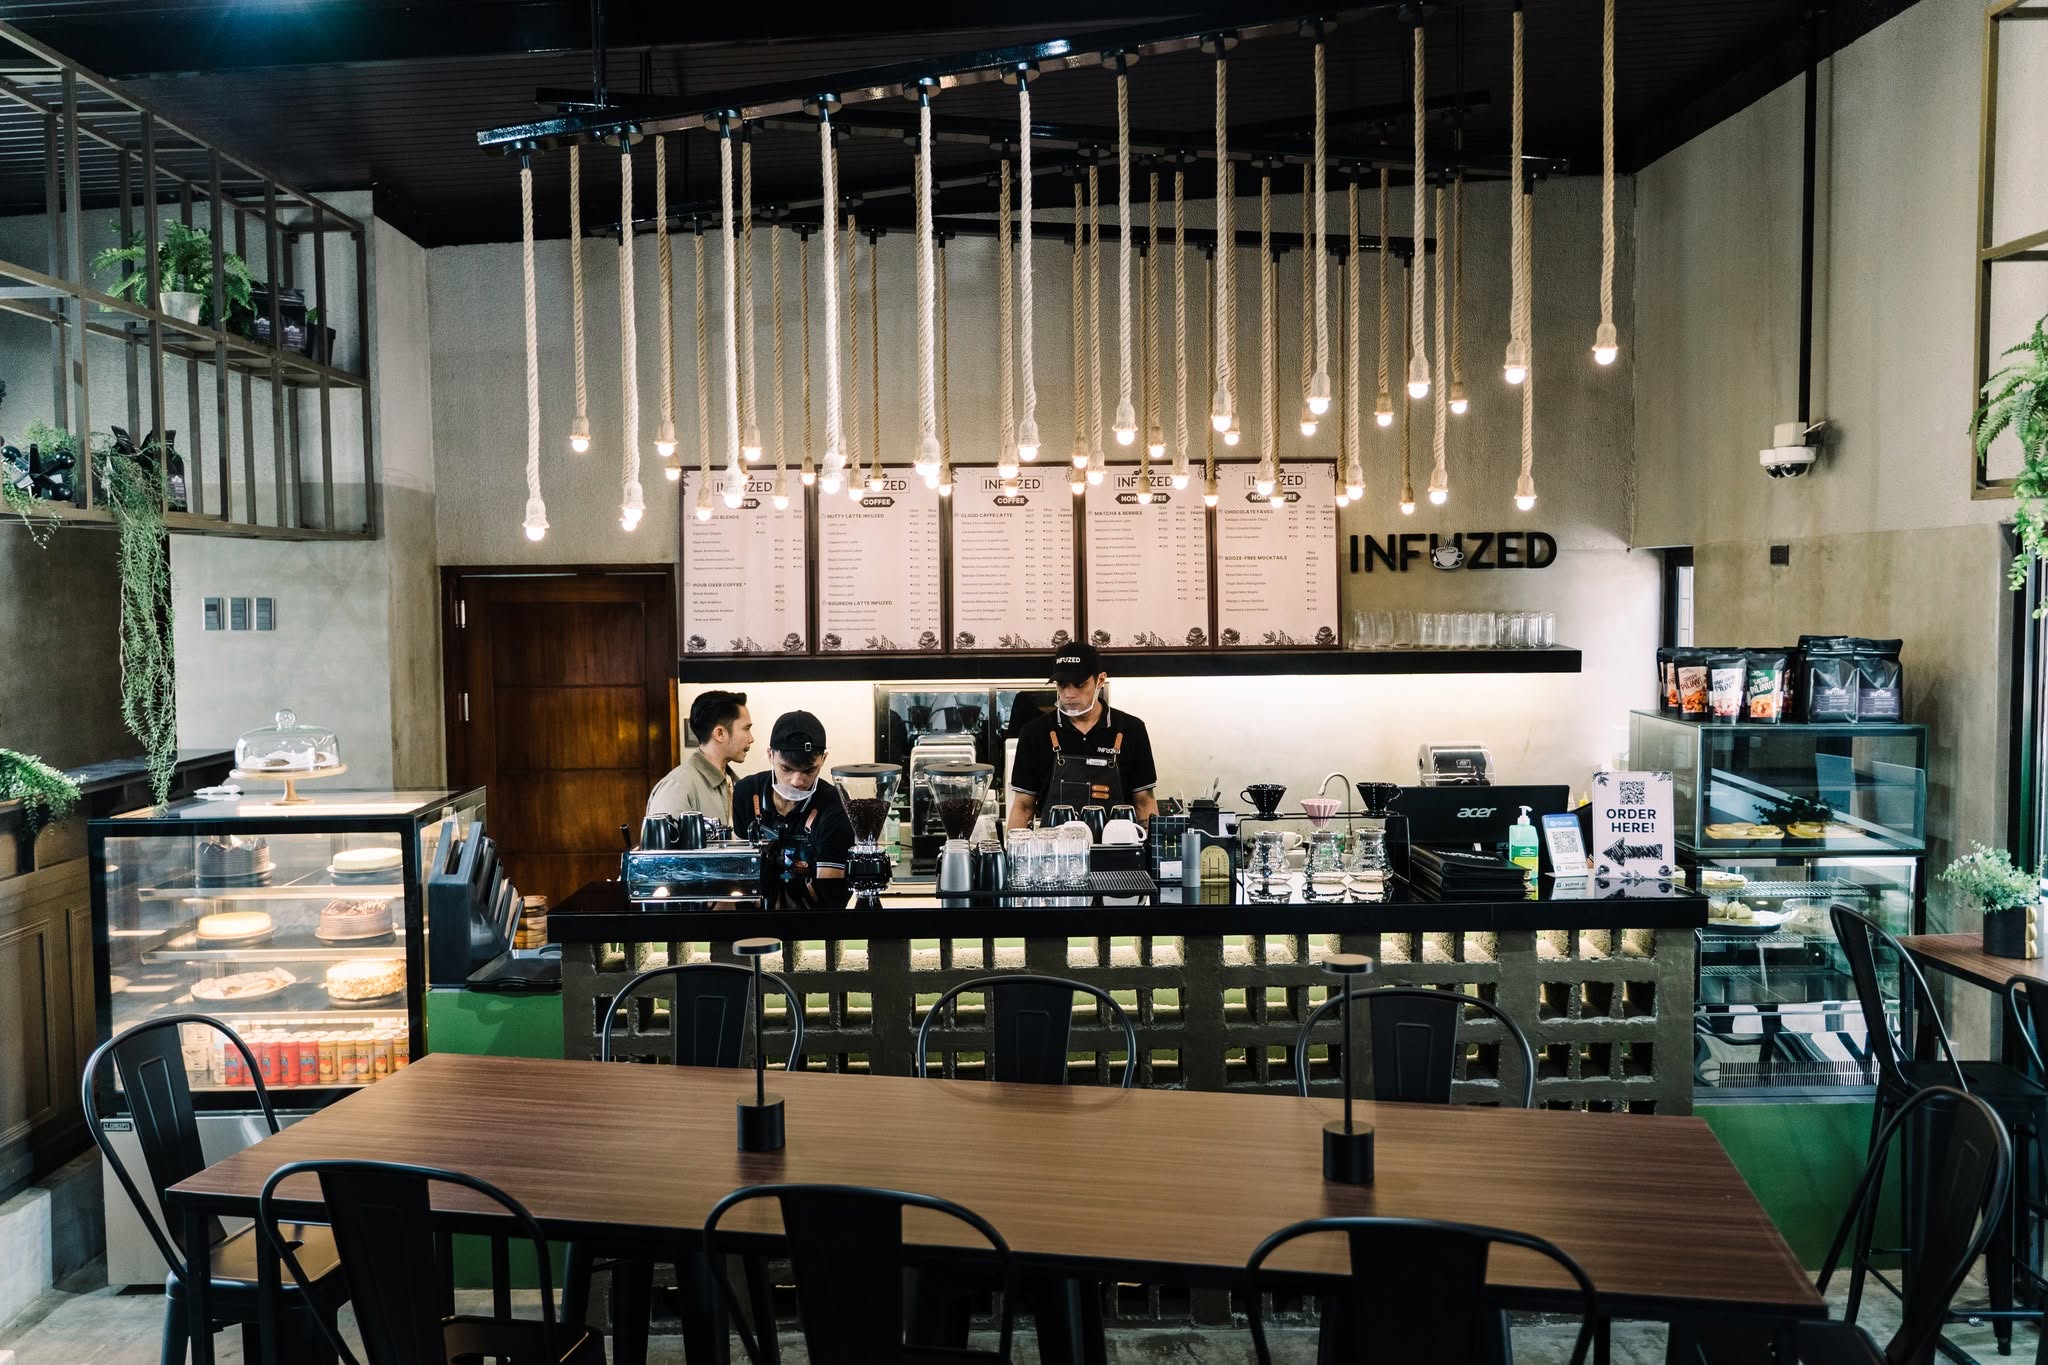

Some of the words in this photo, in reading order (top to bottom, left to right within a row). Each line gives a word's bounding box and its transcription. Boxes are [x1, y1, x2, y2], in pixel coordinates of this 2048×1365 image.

[864, 480, 907, 491] FZED
[984, 479, 1041, 489] INFZED
[1117, 476, 1173, 487] INFZED
[1248, 475, 1304, 486] IZED
[716, 482, 772, 492] IZED
[1350, 532, 1558, 572] INFUZED
[1056, 656, 1081, 664] NFUZED
[1456, 807, 1497, 818] acer
[1606, 808, 1657, 820] ORDER
[1611, 822, 1655, 833] HERE!
